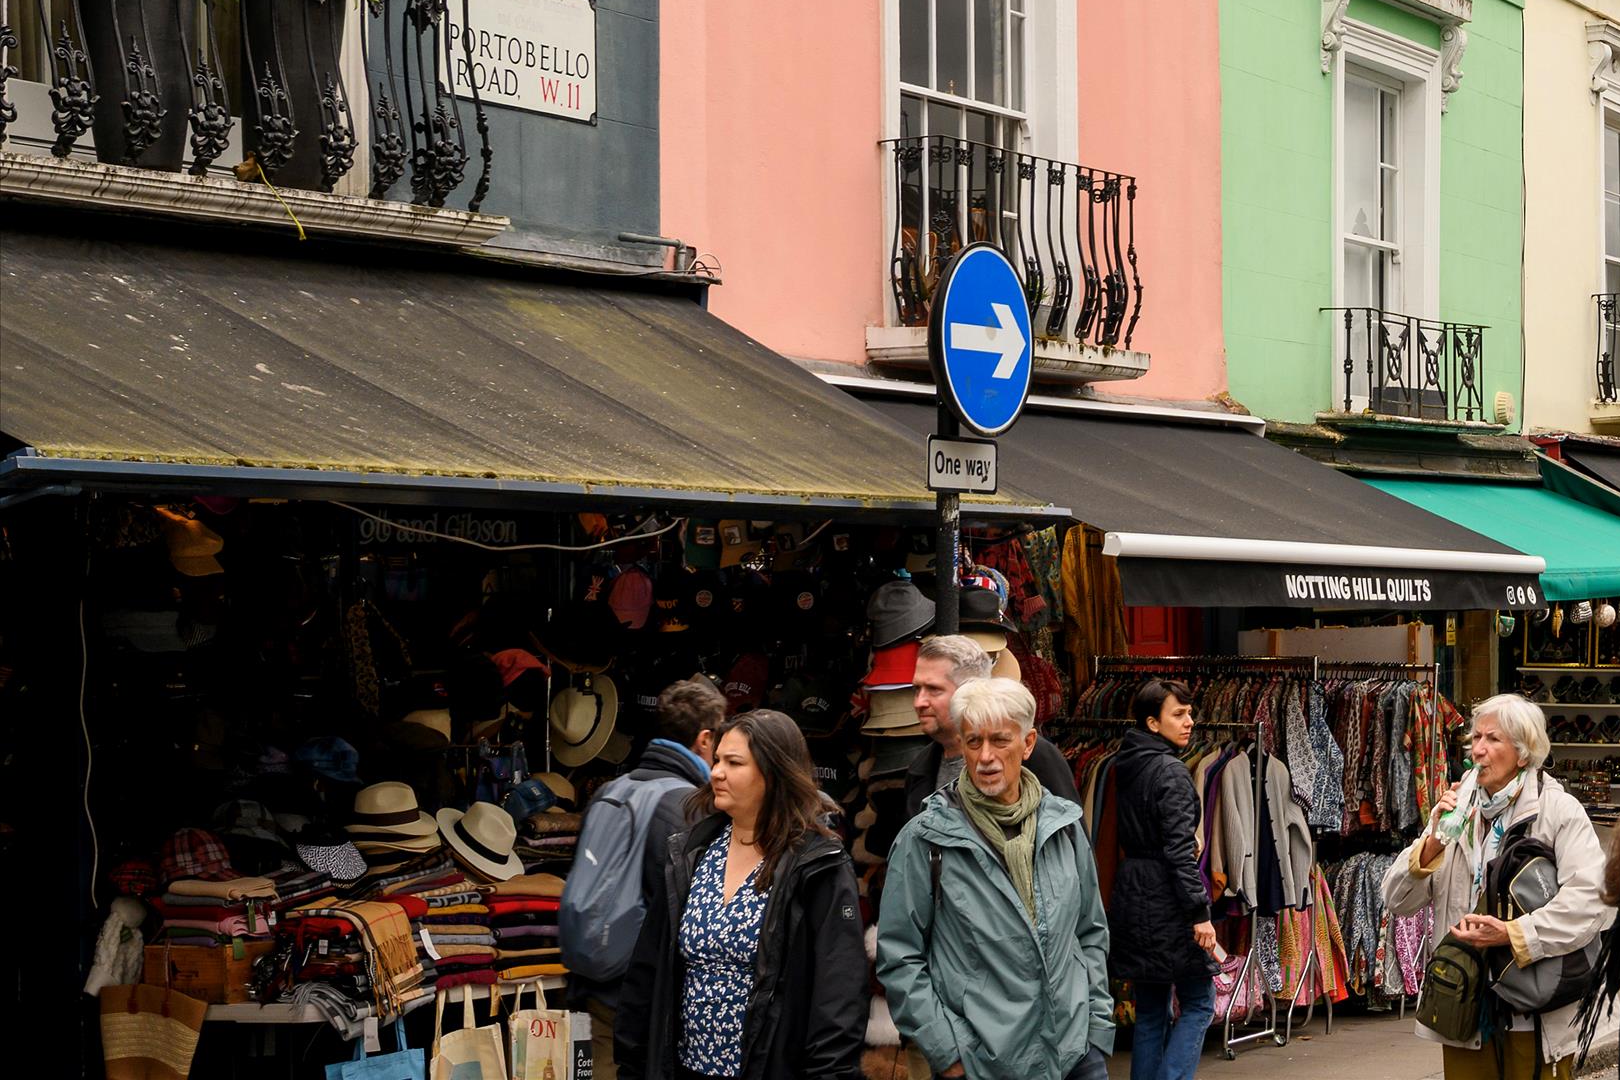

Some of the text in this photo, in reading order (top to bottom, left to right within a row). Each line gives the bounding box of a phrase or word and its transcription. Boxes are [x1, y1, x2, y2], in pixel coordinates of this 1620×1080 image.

[449, 23, 589, 80] PORTOBELLO
[457, 58, 580, 111] ROAD, W.11
[935, 450, 991, 484] One way
[445, 512, 517, 543] Gibson
[1285, 574, 1432, 602] NOTTING HILL QUILTS
[577, 1048, 584, 1058] A
